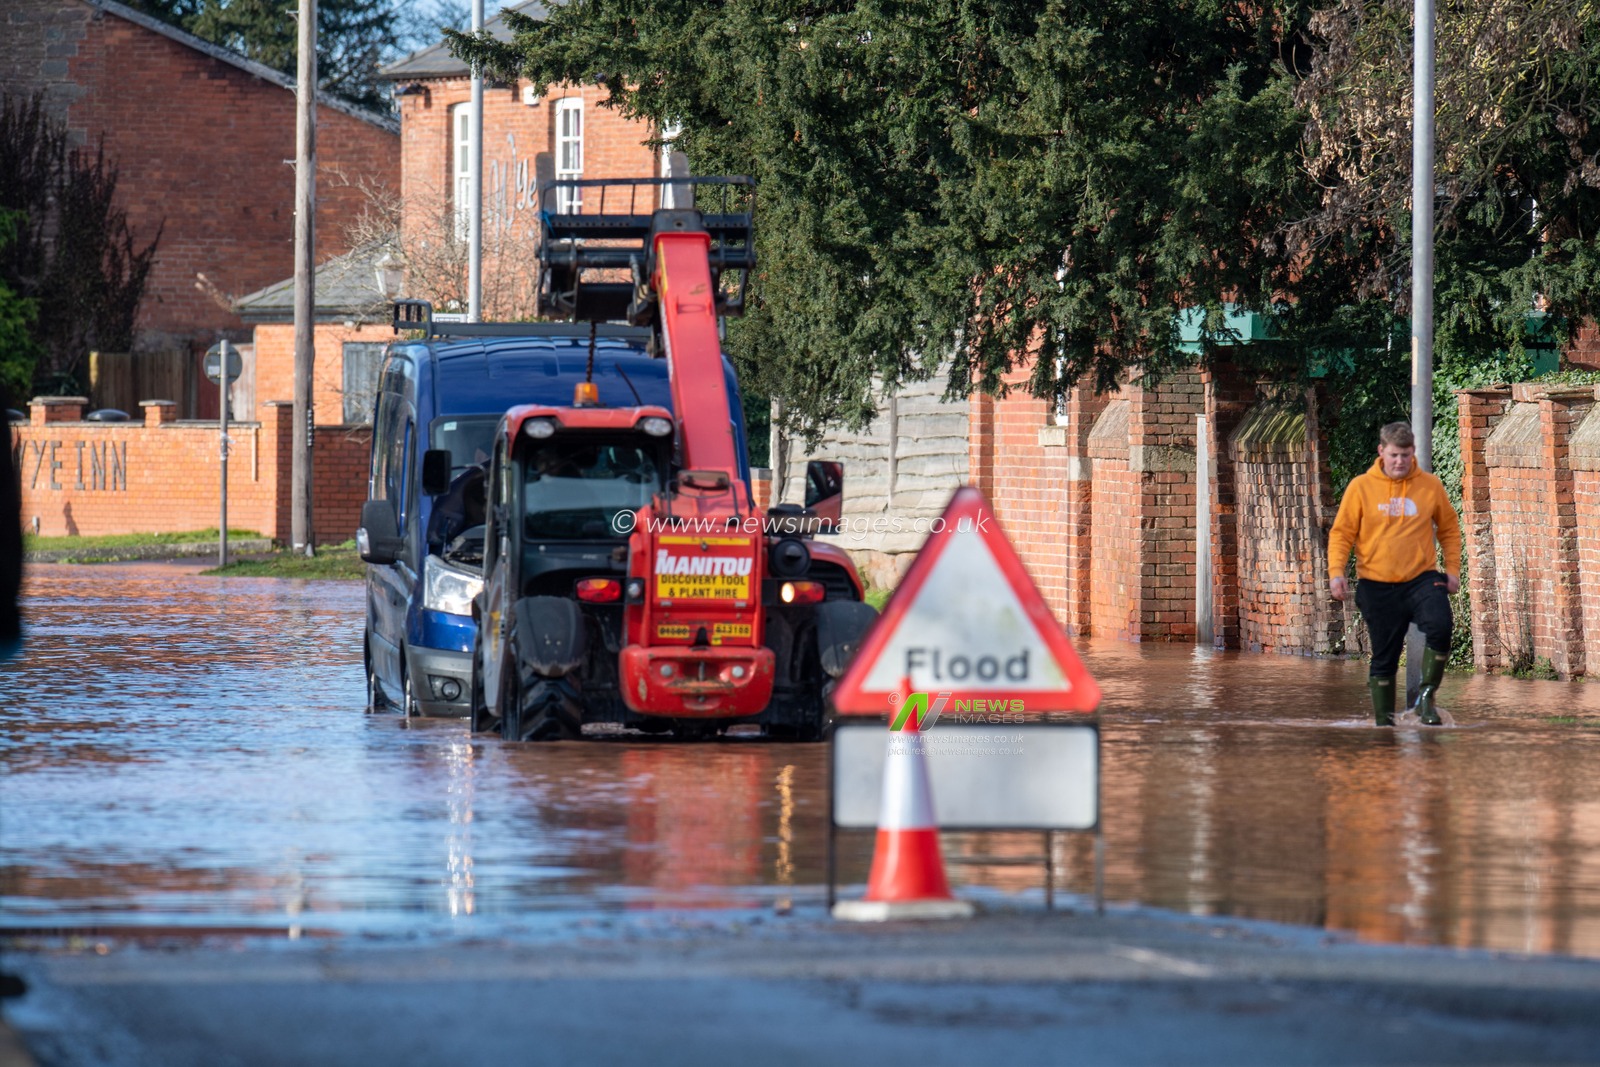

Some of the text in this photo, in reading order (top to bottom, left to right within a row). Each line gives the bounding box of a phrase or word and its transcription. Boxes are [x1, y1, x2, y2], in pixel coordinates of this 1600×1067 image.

[19, 440, 127, 491] YE INN
[655, 555, 753, 576] MANITOU
[661, 574, 746, 586] DISCOVERY TOOL
[668, 588, 738, 598] & PLANT HIRE
[905, 646, 1030, 682] Flood
